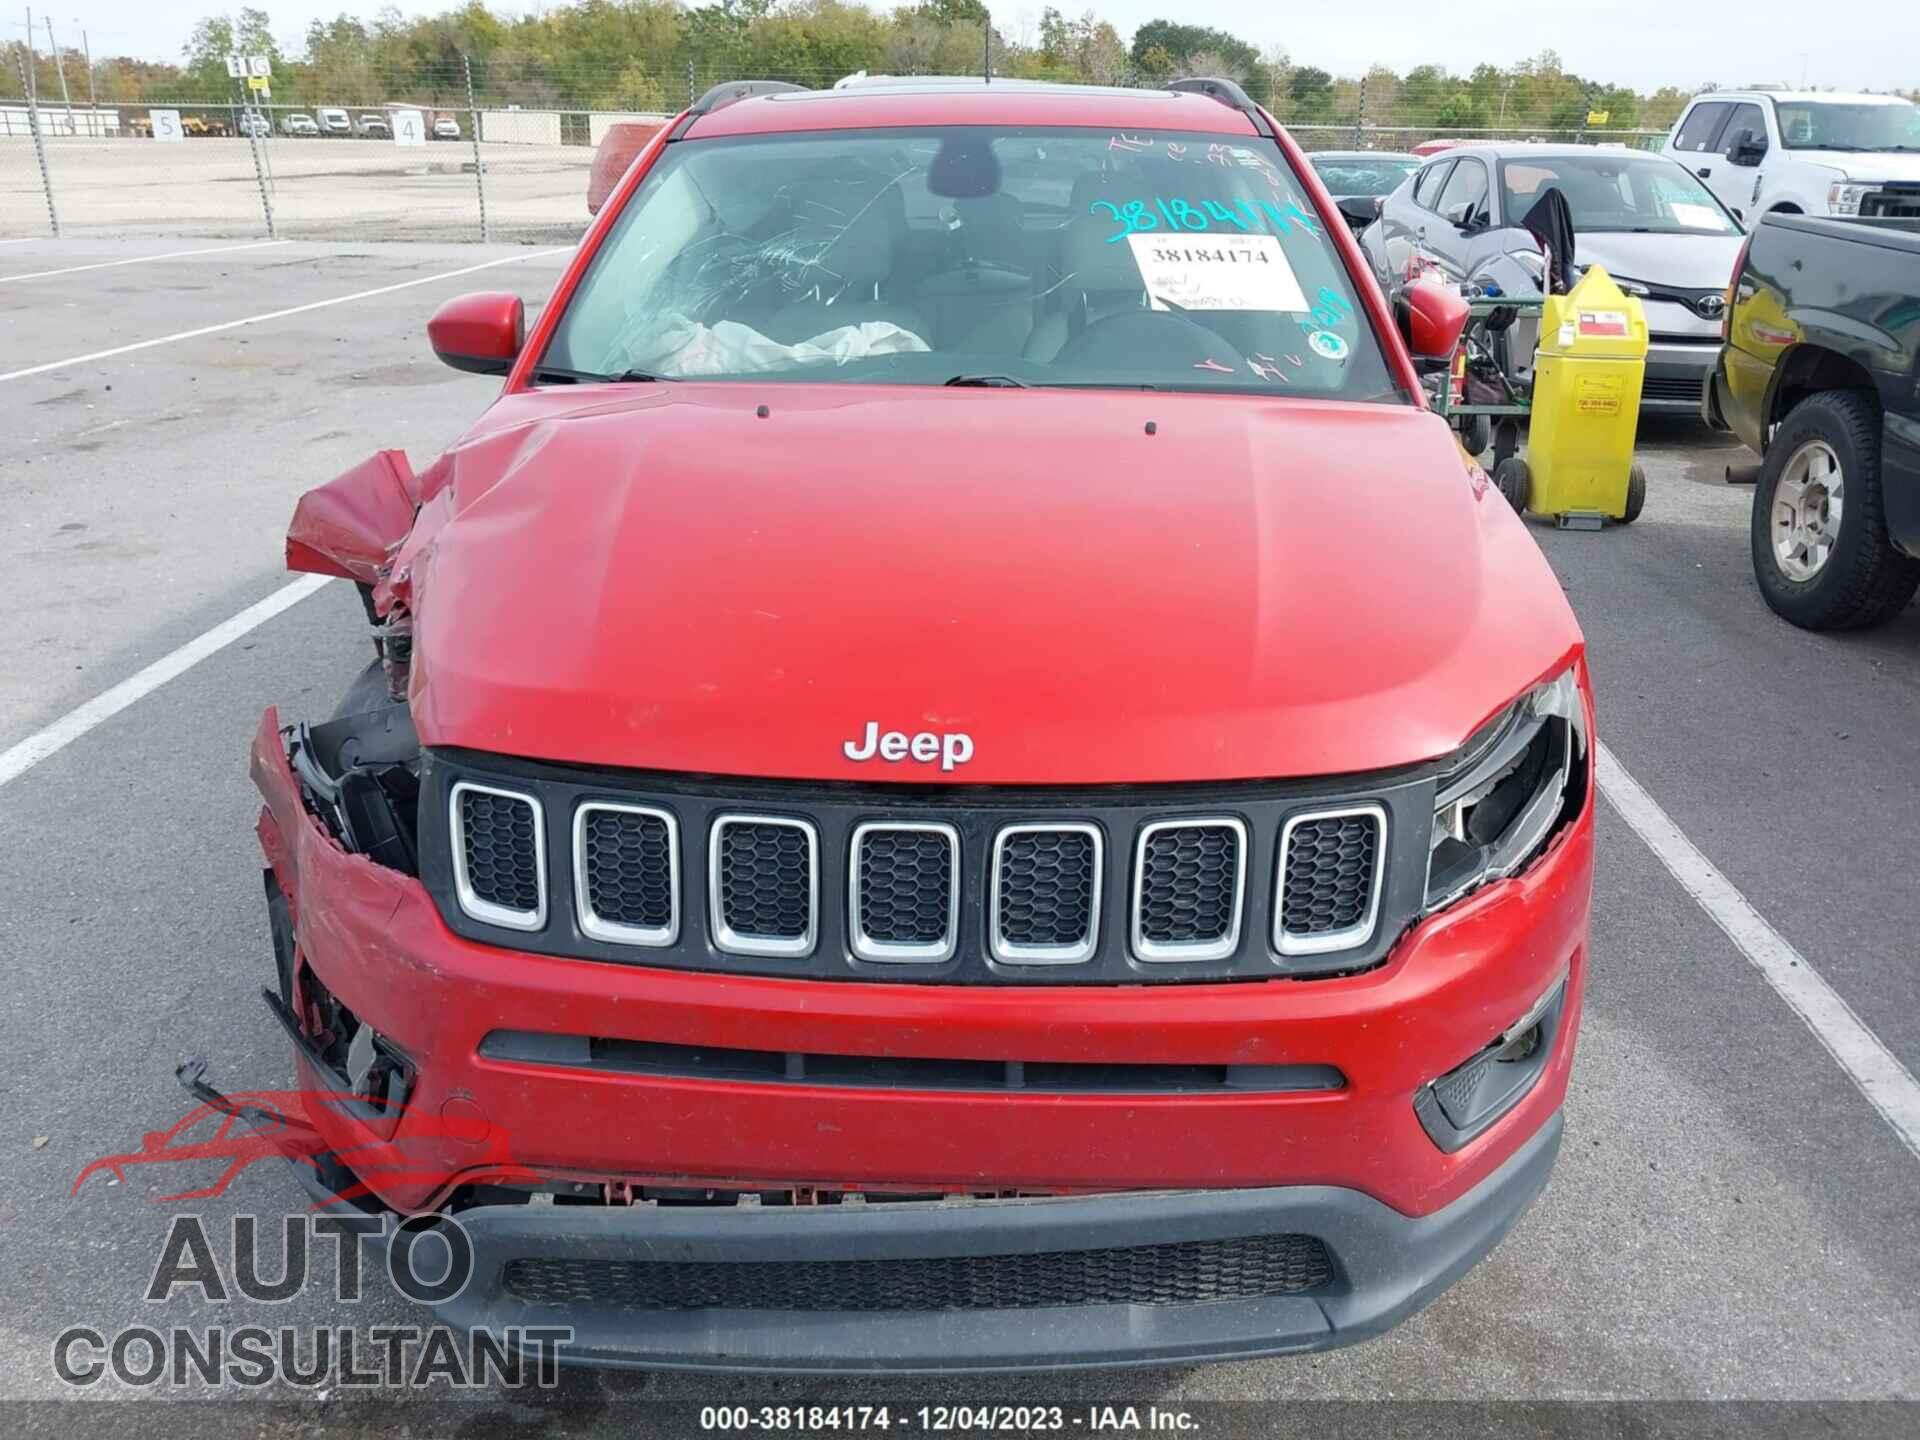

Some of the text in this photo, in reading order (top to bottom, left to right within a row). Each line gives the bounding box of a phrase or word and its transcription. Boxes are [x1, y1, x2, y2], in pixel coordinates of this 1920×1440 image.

[160, 116, 174, 136] 5
[403, 119, 416, 140] 4
[1151, 248, 1270, 264] 38184174
[843, 721, 974, 770] Jeep
